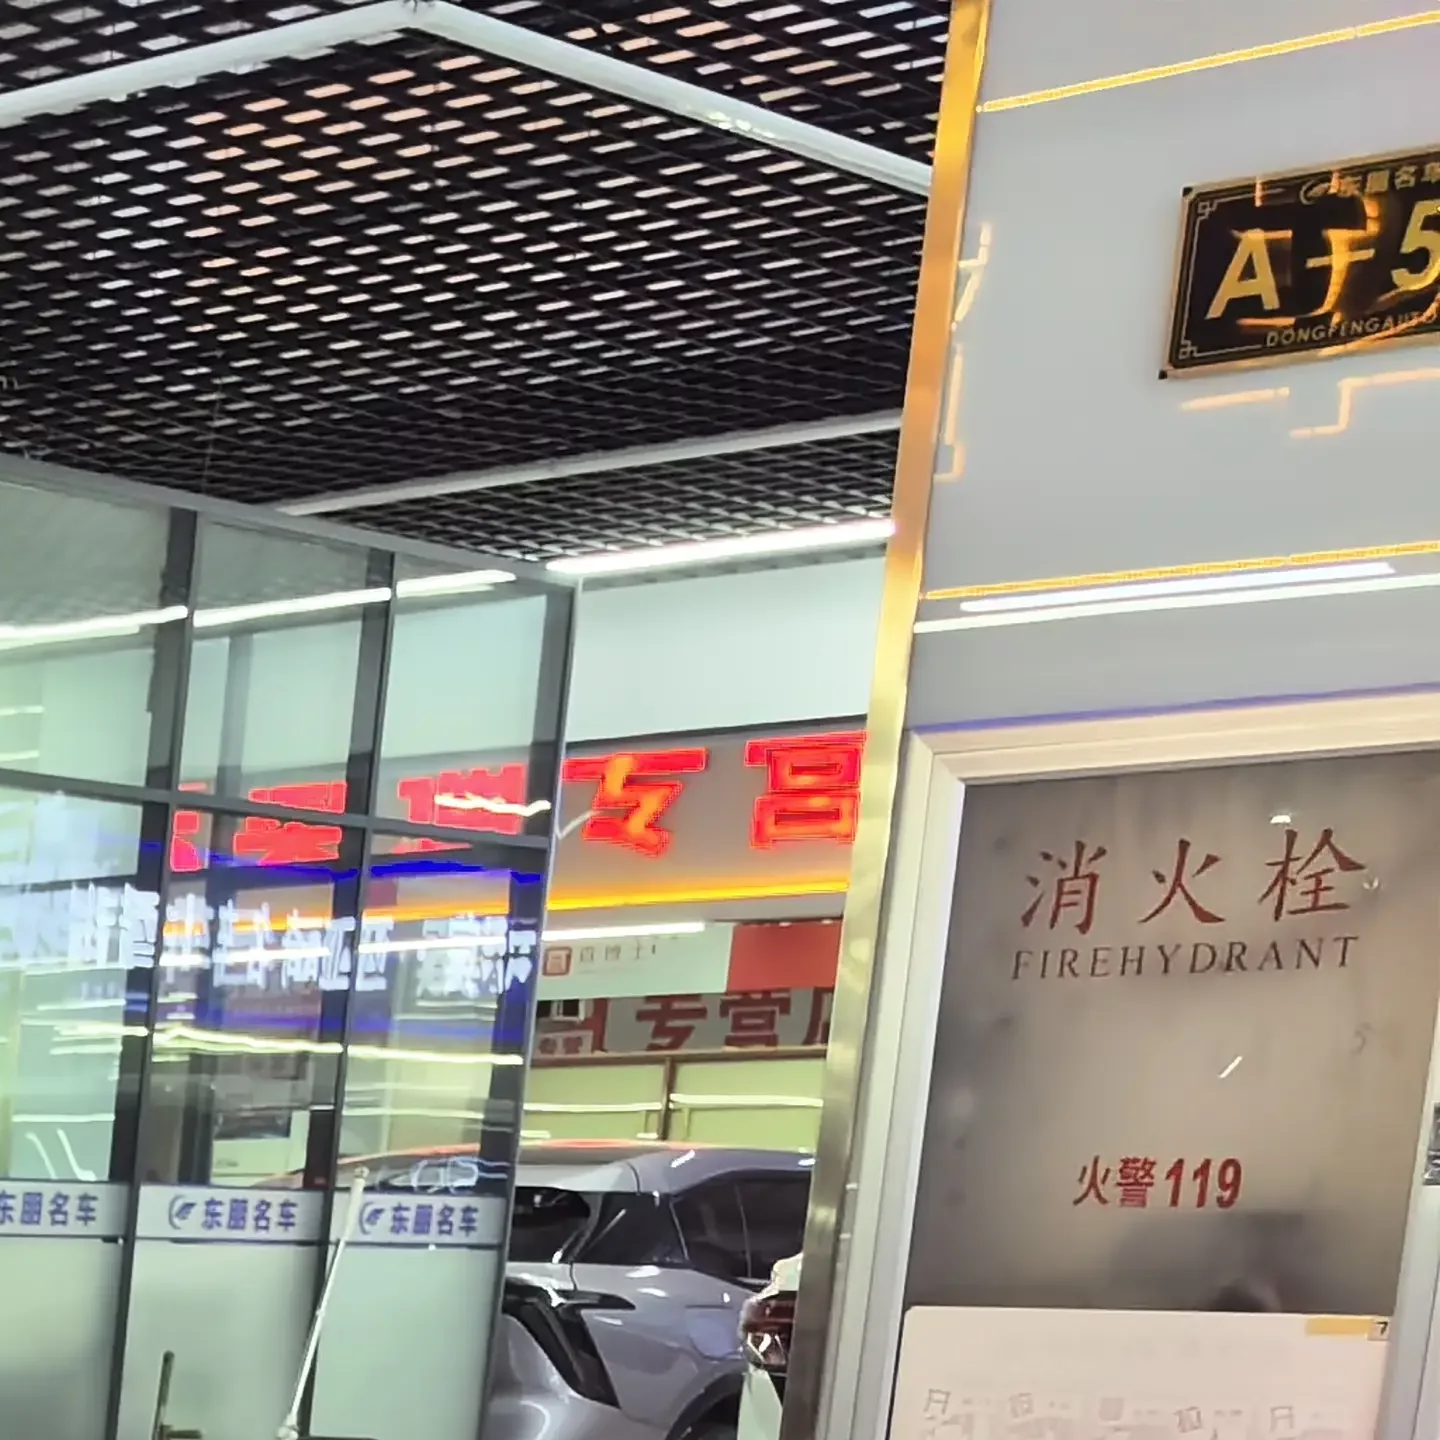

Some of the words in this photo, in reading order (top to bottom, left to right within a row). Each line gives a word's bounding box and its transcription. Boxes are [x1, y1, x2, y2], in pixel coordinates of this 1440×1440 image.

[1021, 827, 1368, 936] 消火栓
[1073, 1154, 1244, 1209] 火警119
